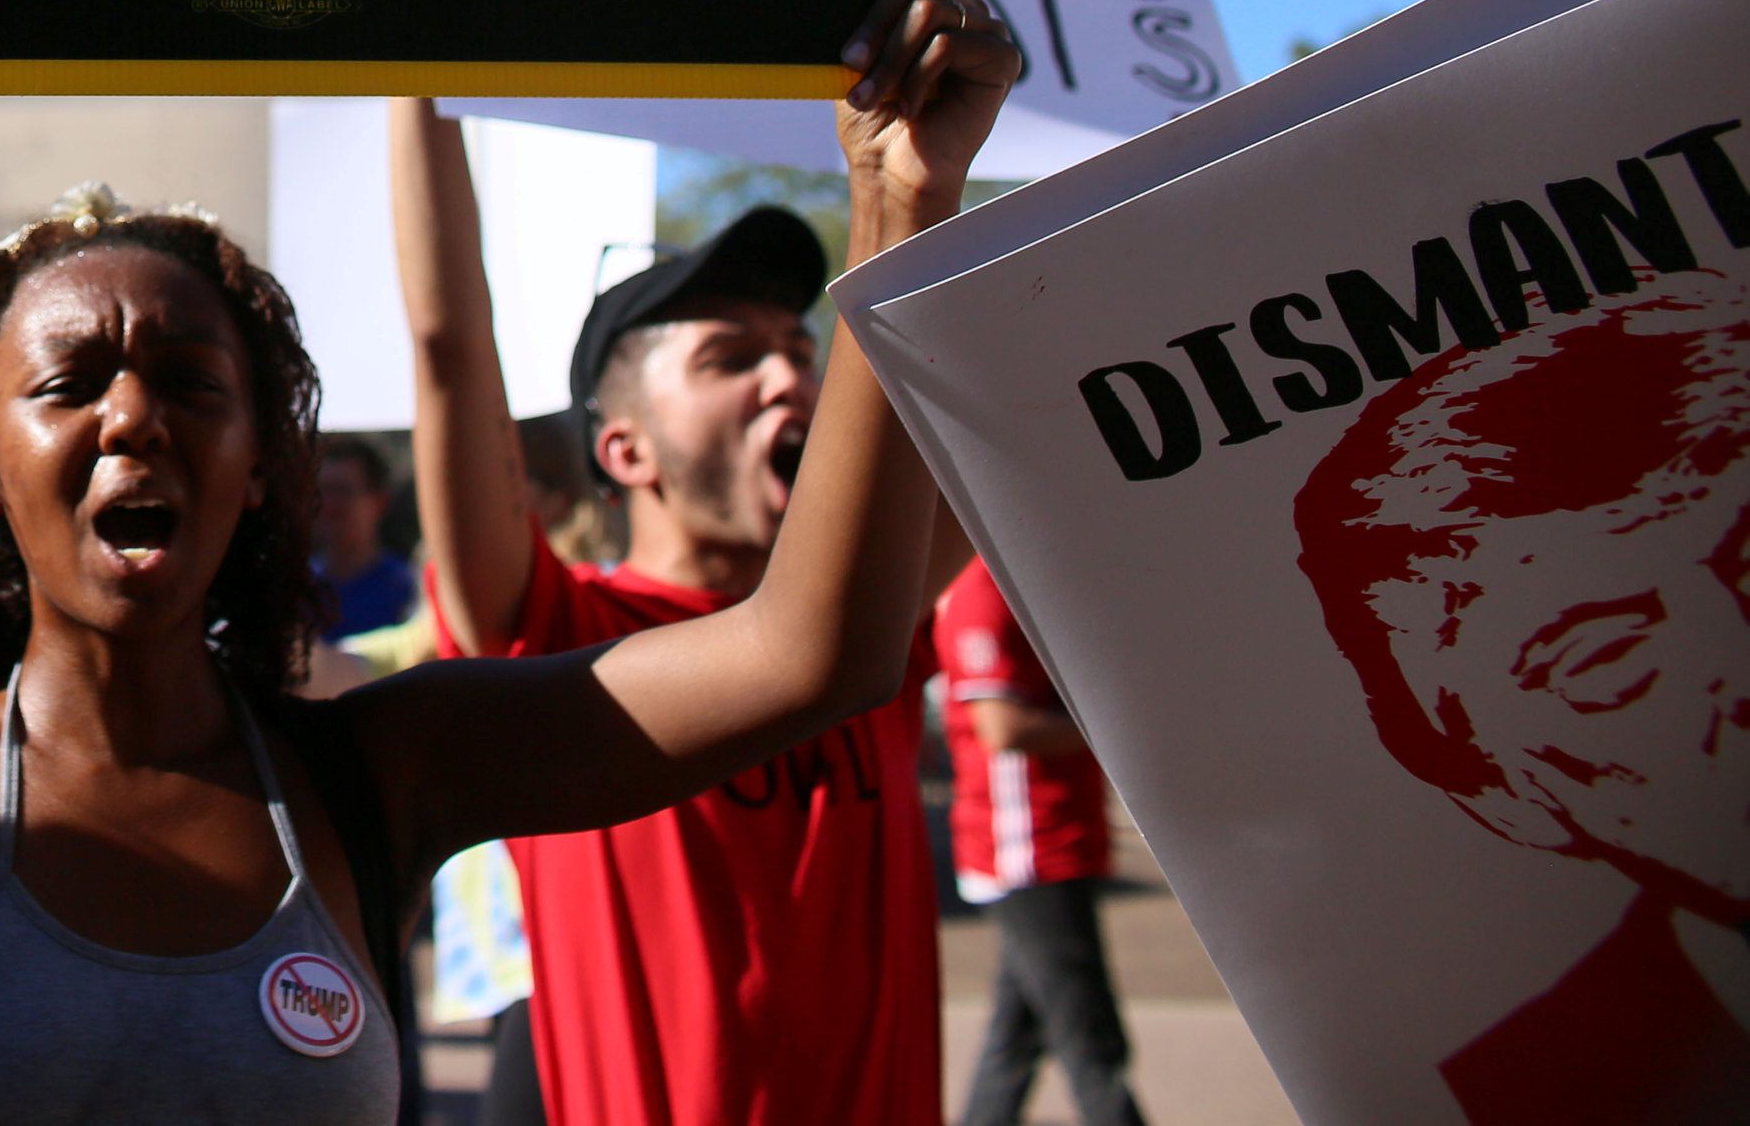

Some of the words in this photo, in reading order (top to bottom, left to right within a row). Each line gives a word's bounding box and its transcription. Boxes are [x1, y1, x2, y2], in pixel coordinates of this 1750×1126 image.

[219, 0, 263, 9] UNION
[299, 0, 342, 10] LABEL
[1077, 118, 1750, 482] DISMANT
[280, 978, 349, 1023] TRUMP
